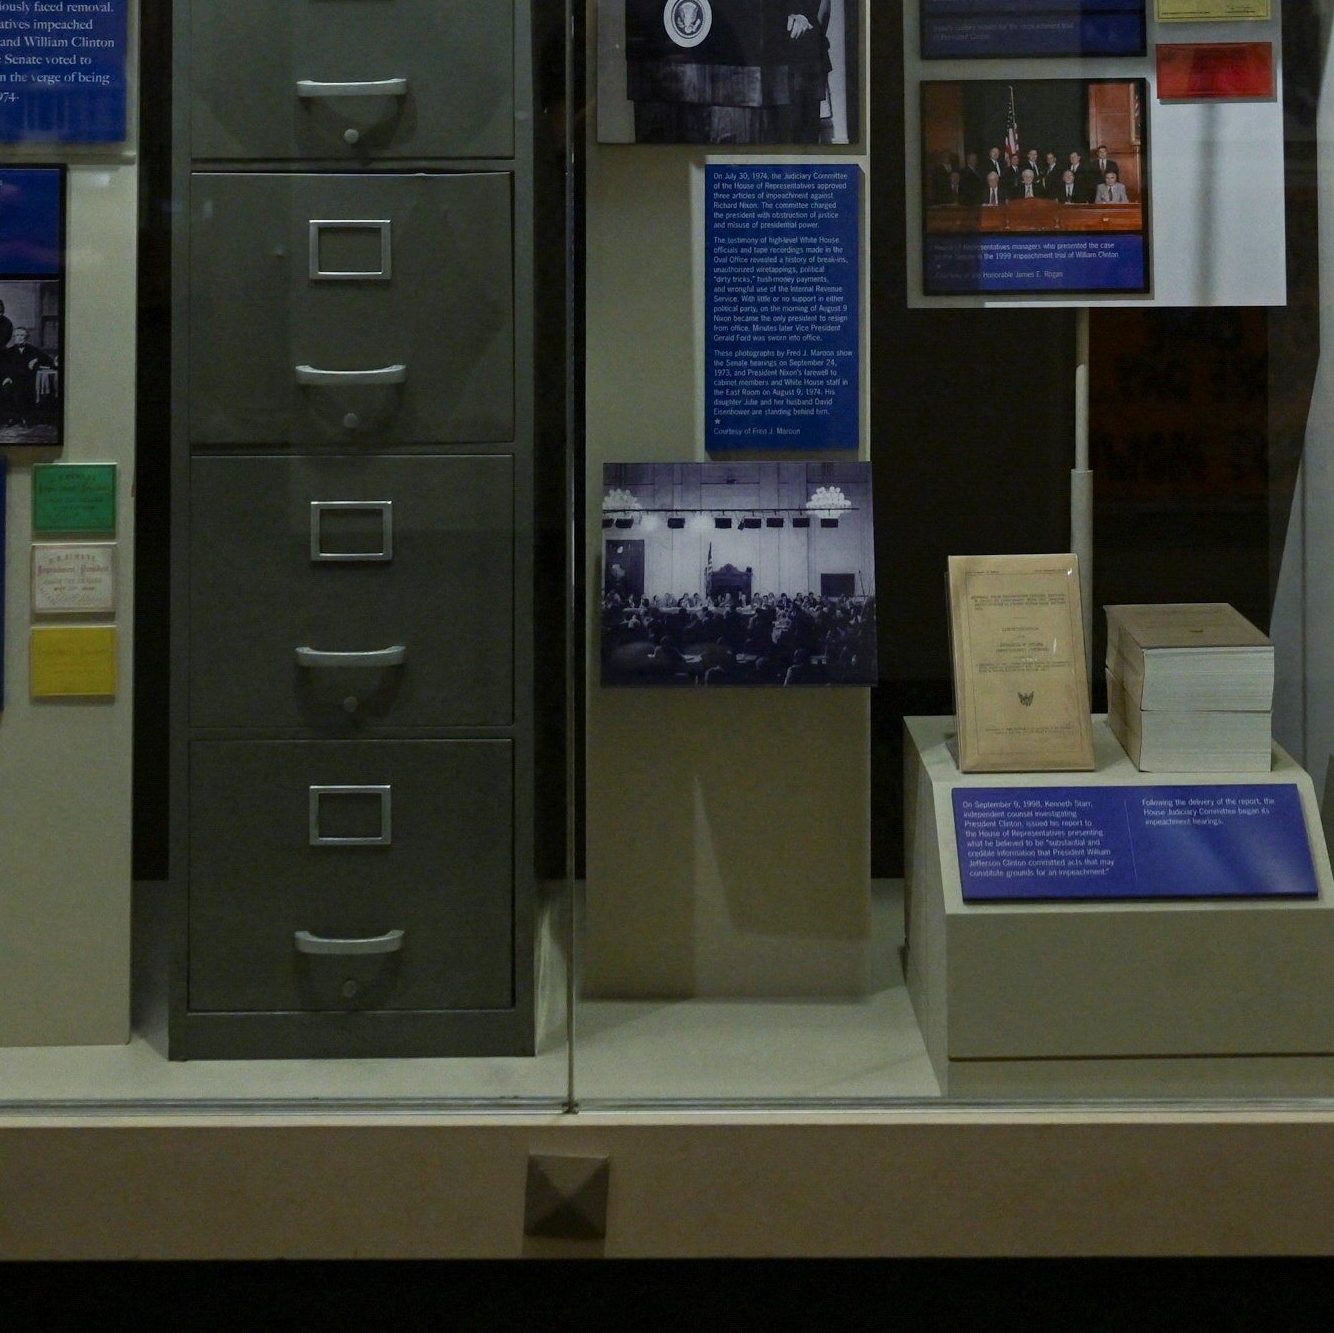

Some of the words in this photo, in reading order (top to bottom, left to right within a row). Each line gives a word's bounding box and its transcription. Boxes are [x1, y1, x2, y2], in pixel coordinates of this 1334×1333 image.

[33, 0, 63, 11] faced
[33, 18, 93, 33] impeached
[0, 35, 20, 46] and
[23, 35, 68, 46] William
[71, 36, 115, 47] Clinton
[4, 53, 42, 64] Senate
[45, 53, 76, 64] voted
[79, 53, 91, 64] to
[714, 172, 722, 180] On
[724, 172, 736, 181] July
[783, 172, 811, 181] Judiciary
[974, 800, 1011, 810] September
